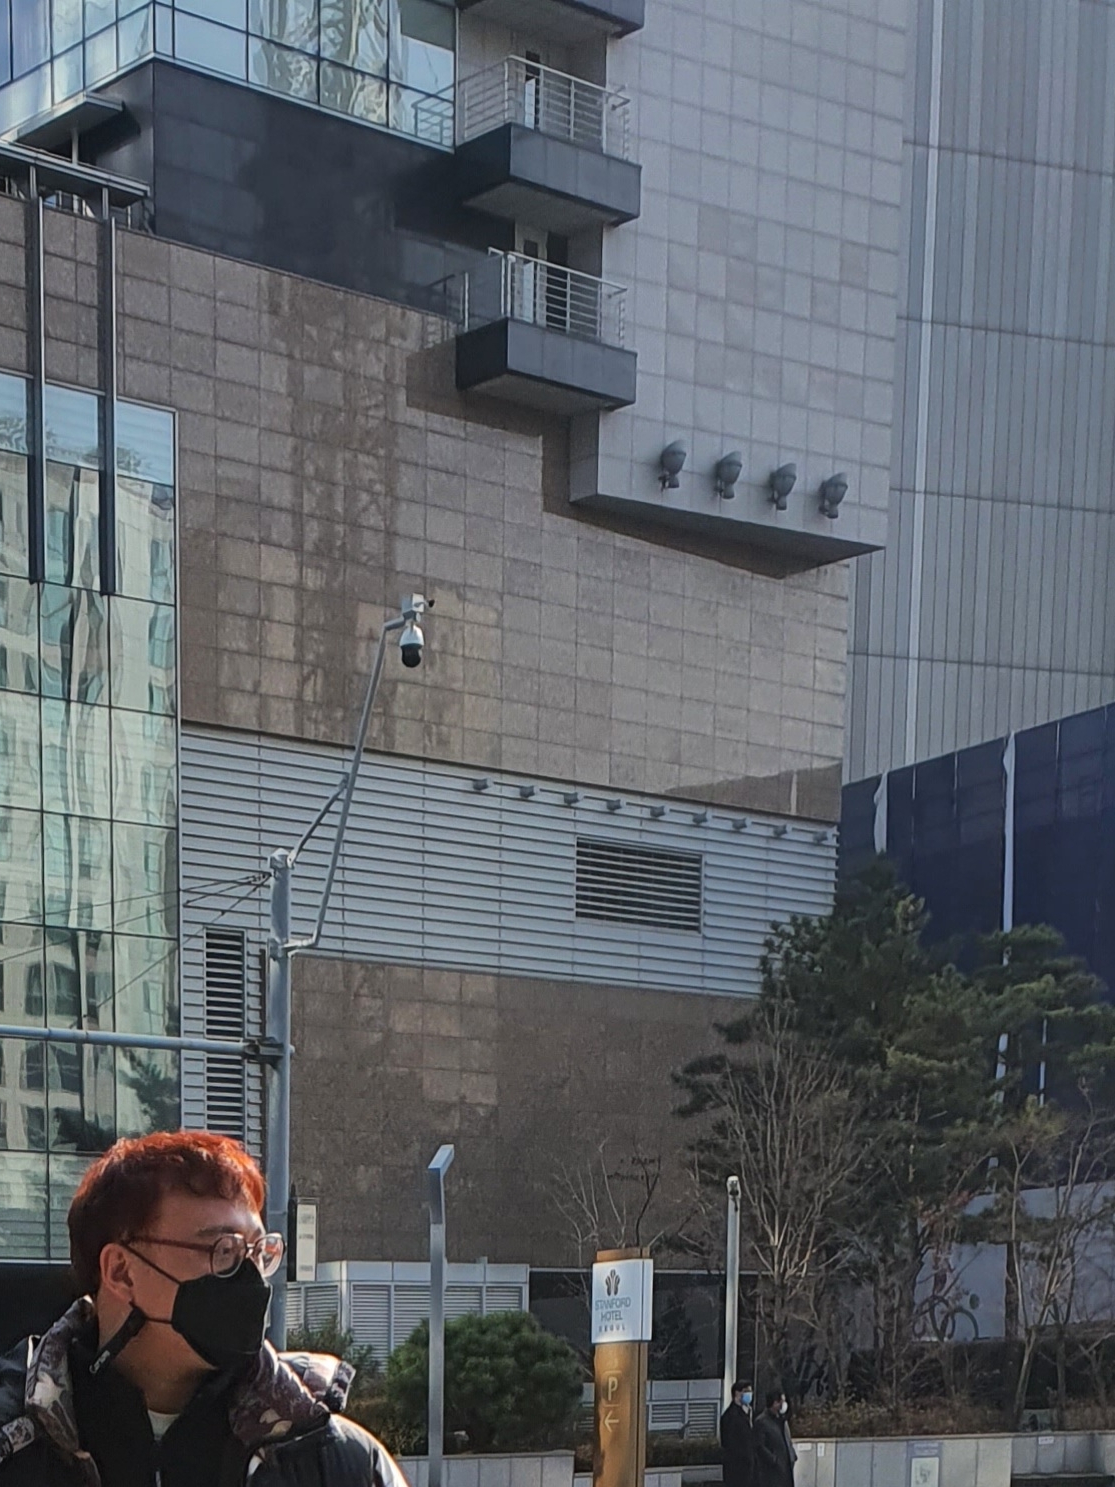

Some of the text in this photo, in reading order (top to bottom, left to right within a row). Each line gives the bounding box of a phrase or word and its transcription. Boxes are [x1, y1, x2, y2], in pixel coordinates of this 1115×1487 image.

[594, 1297, 632, 1311] STANFORD
[600, 1310, 623, 1322] HOTEL
[607, 1376, 618, 1401] P
